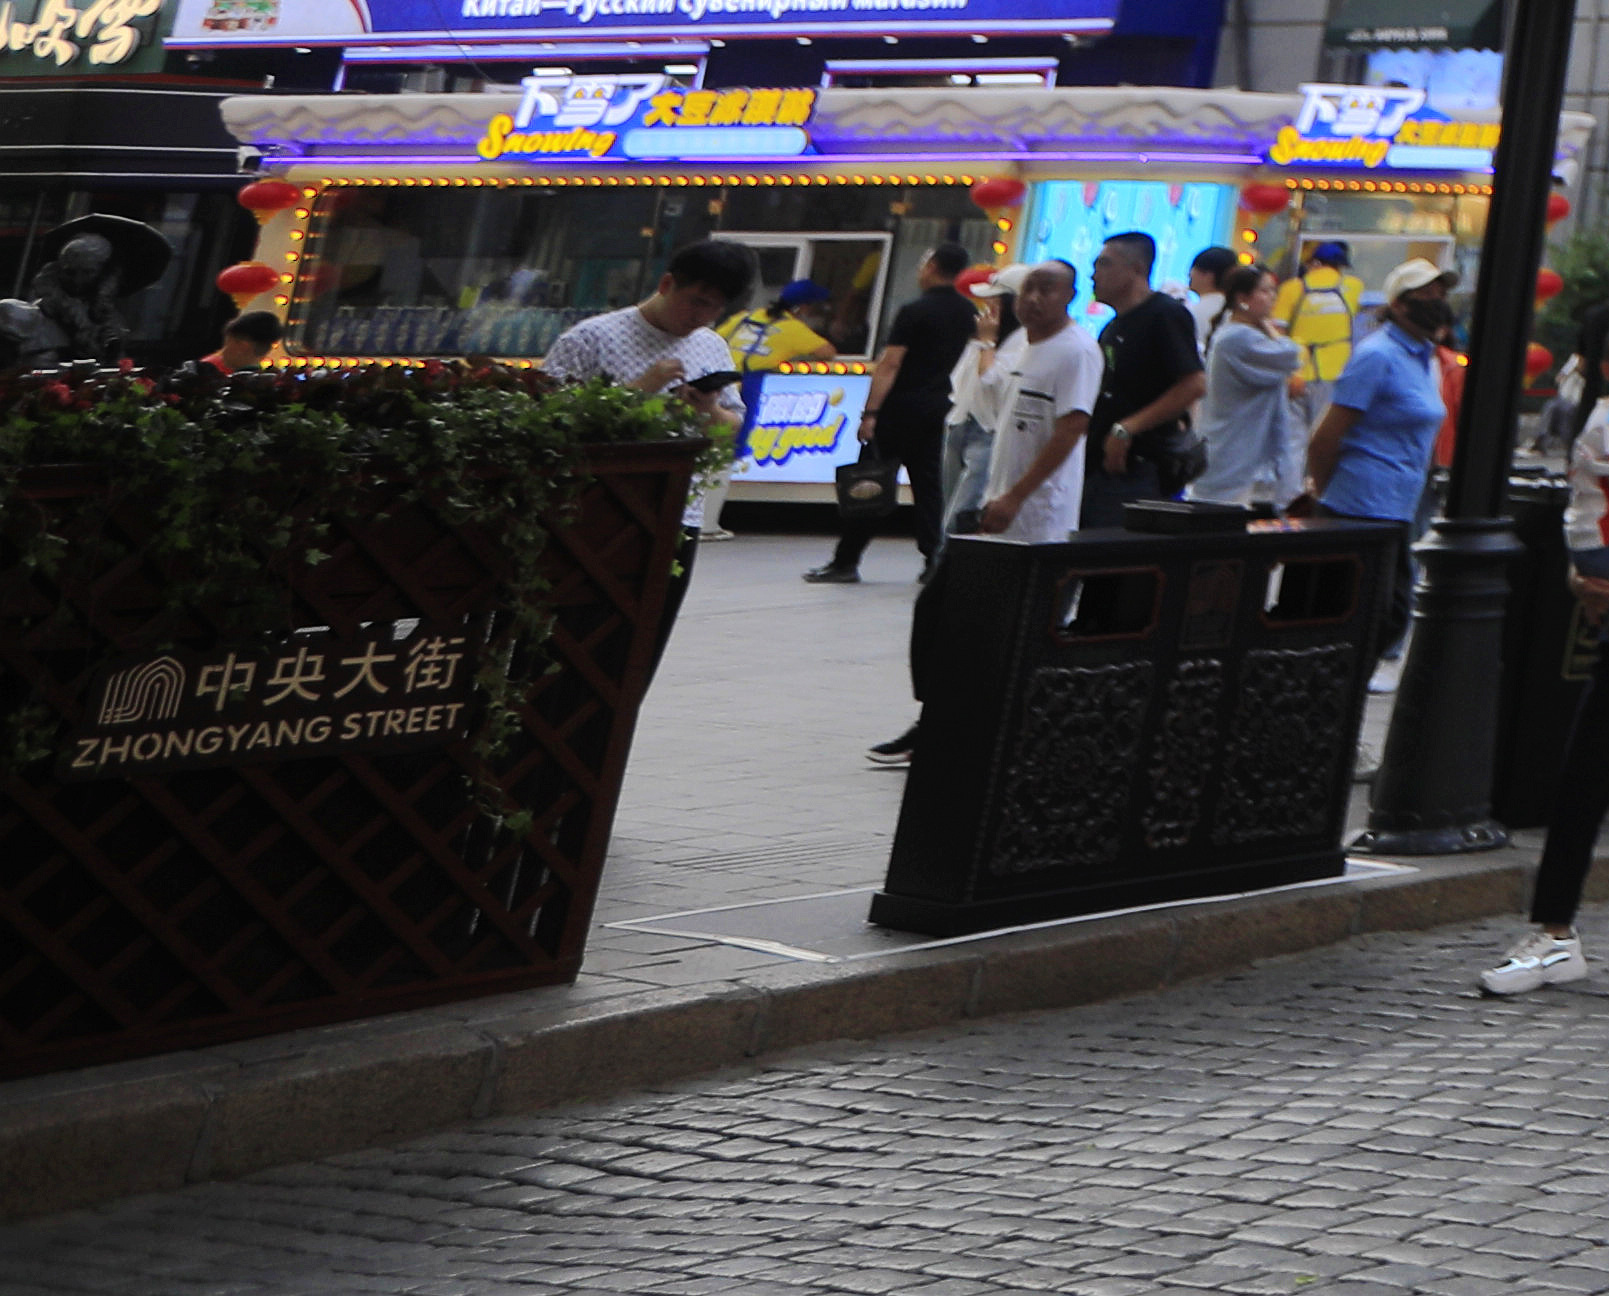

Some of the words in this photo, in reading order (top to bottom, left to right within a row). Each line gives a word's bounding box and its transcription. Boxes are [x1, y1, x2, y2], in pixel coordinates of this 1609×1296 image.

[514, 73, 667, 129] 下雪了
[1296, 83, 1427, 136] 下雪了
[478, 113, 617, 159] Snowing
[195, 635, 466, 712] 中央大街
[71, 715, 332, 769] ZHONGYANG
[339, 703, 465, 740] STREET
